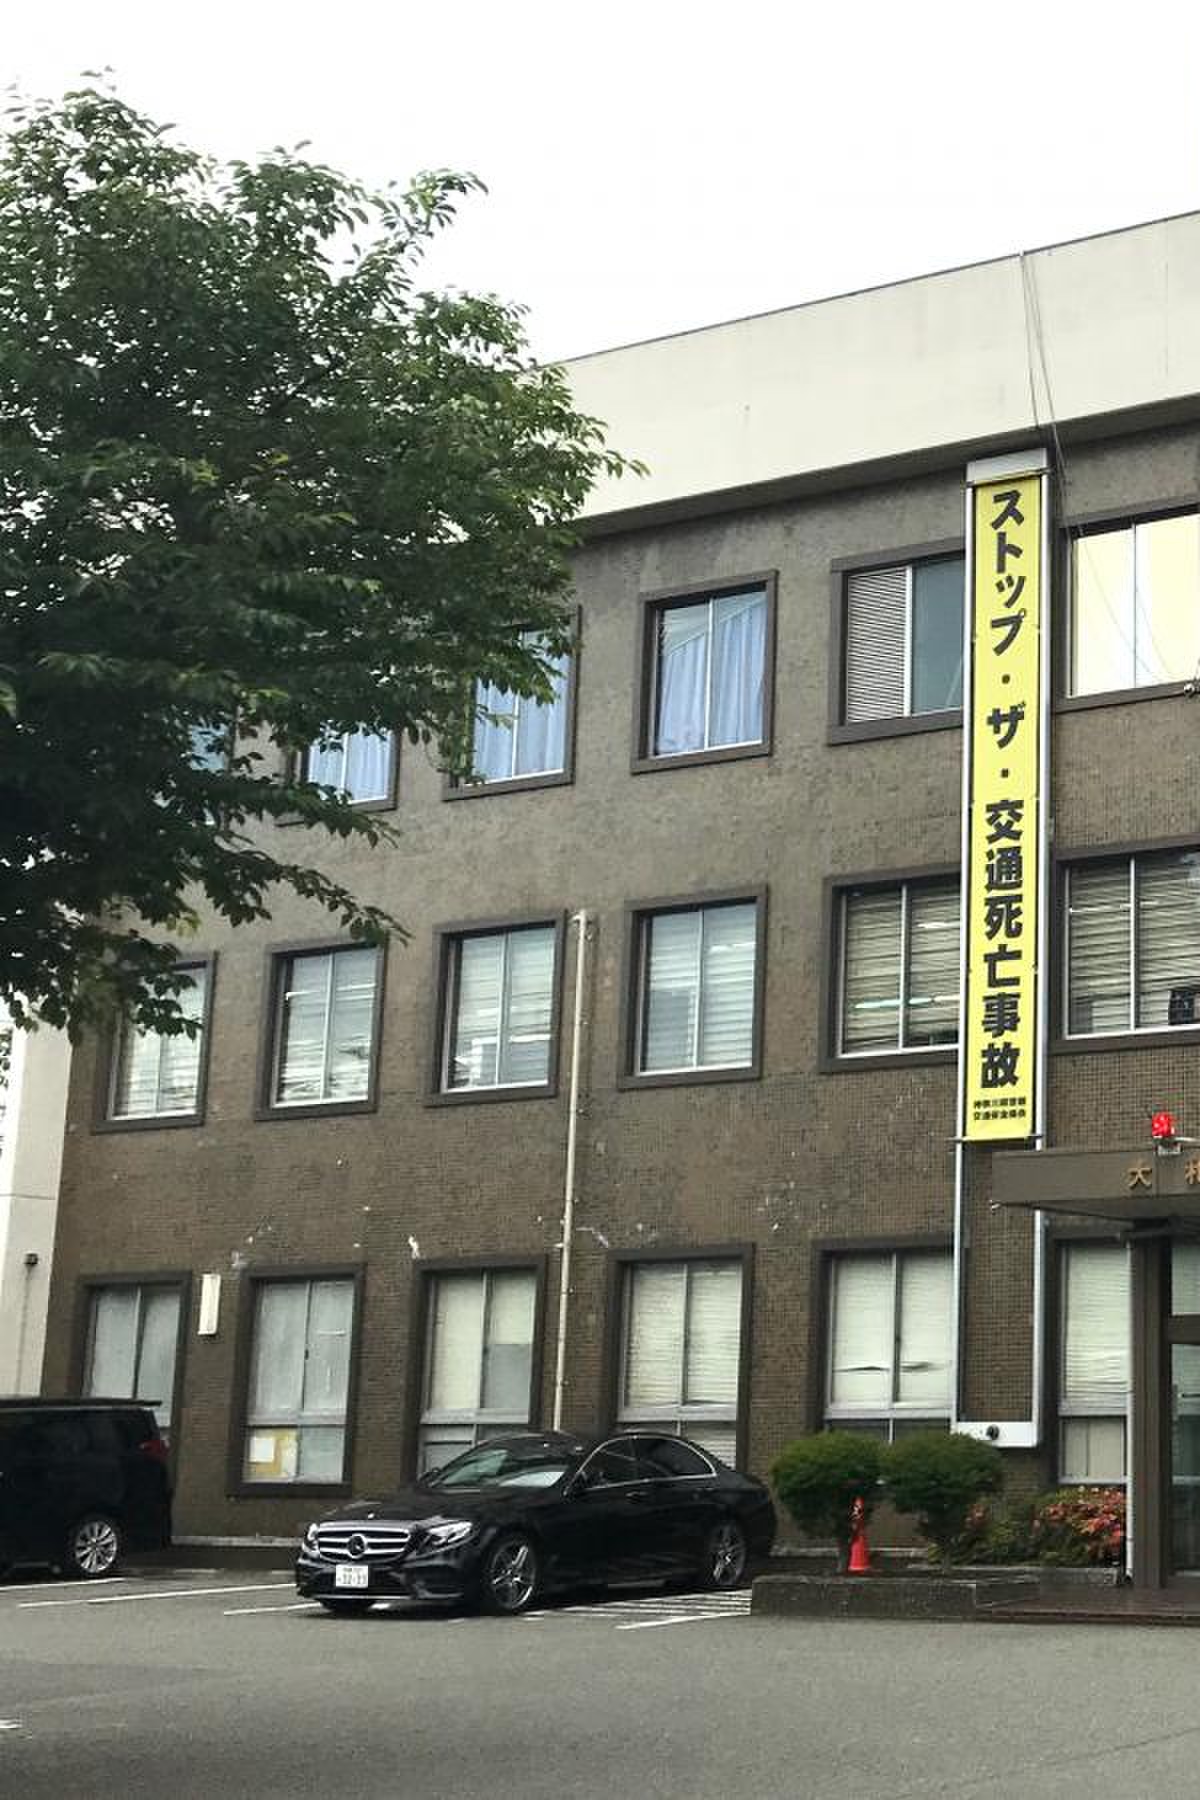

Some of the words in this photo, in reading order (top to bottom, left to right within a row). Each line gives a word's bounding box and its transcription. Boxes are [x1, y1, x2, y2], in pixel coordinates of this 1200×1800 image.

[980, 488, 1027, 1089] ストップ・ザ・交通死亡事故
